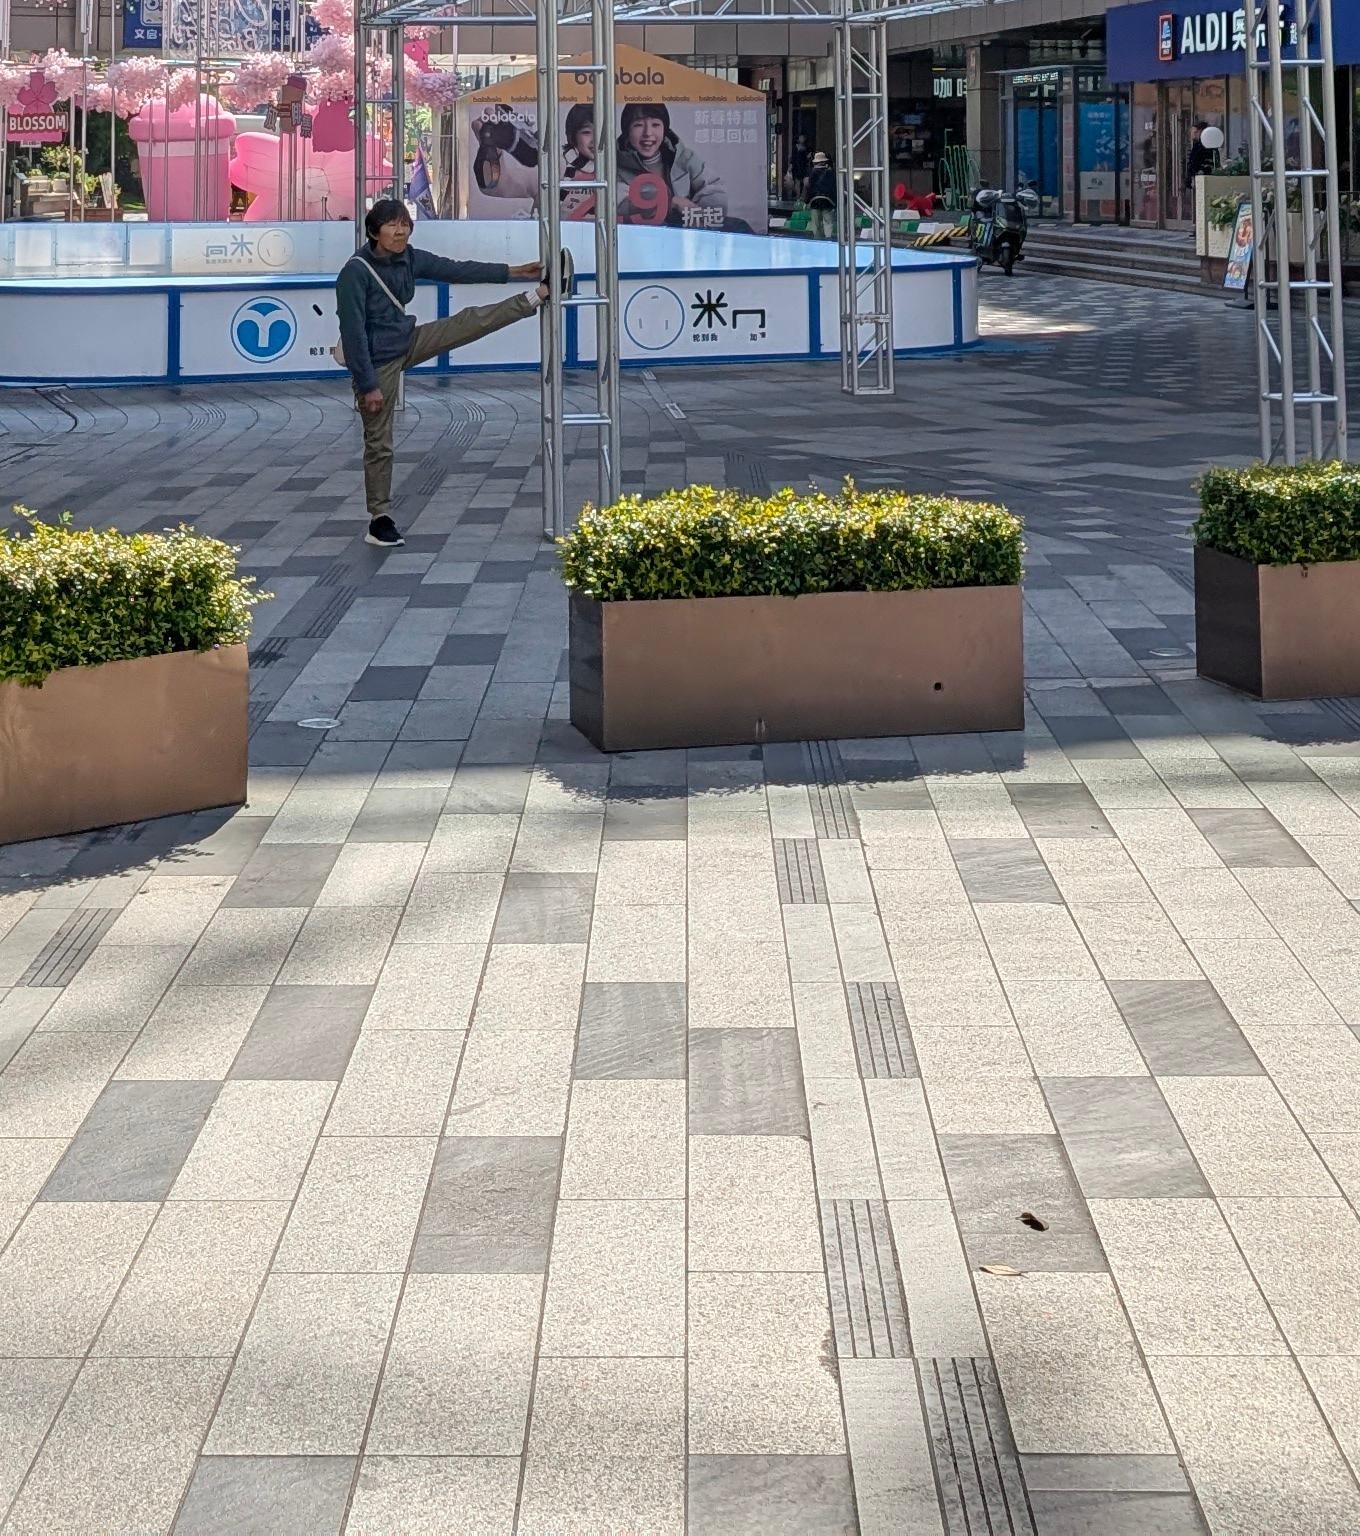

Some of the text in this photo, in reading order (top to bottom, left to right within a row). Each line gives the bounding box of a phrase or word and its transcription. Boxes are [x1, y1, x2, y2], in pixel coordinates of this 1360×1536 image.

[1180, 11, 1227, 55] ALDI
[9, 115, 66, 131] BLOSSOM
[480, 109, 536, 125] balabala
[694, 110, 757, 126] 新春特惠
[681, 207, 725, 228] 折起
